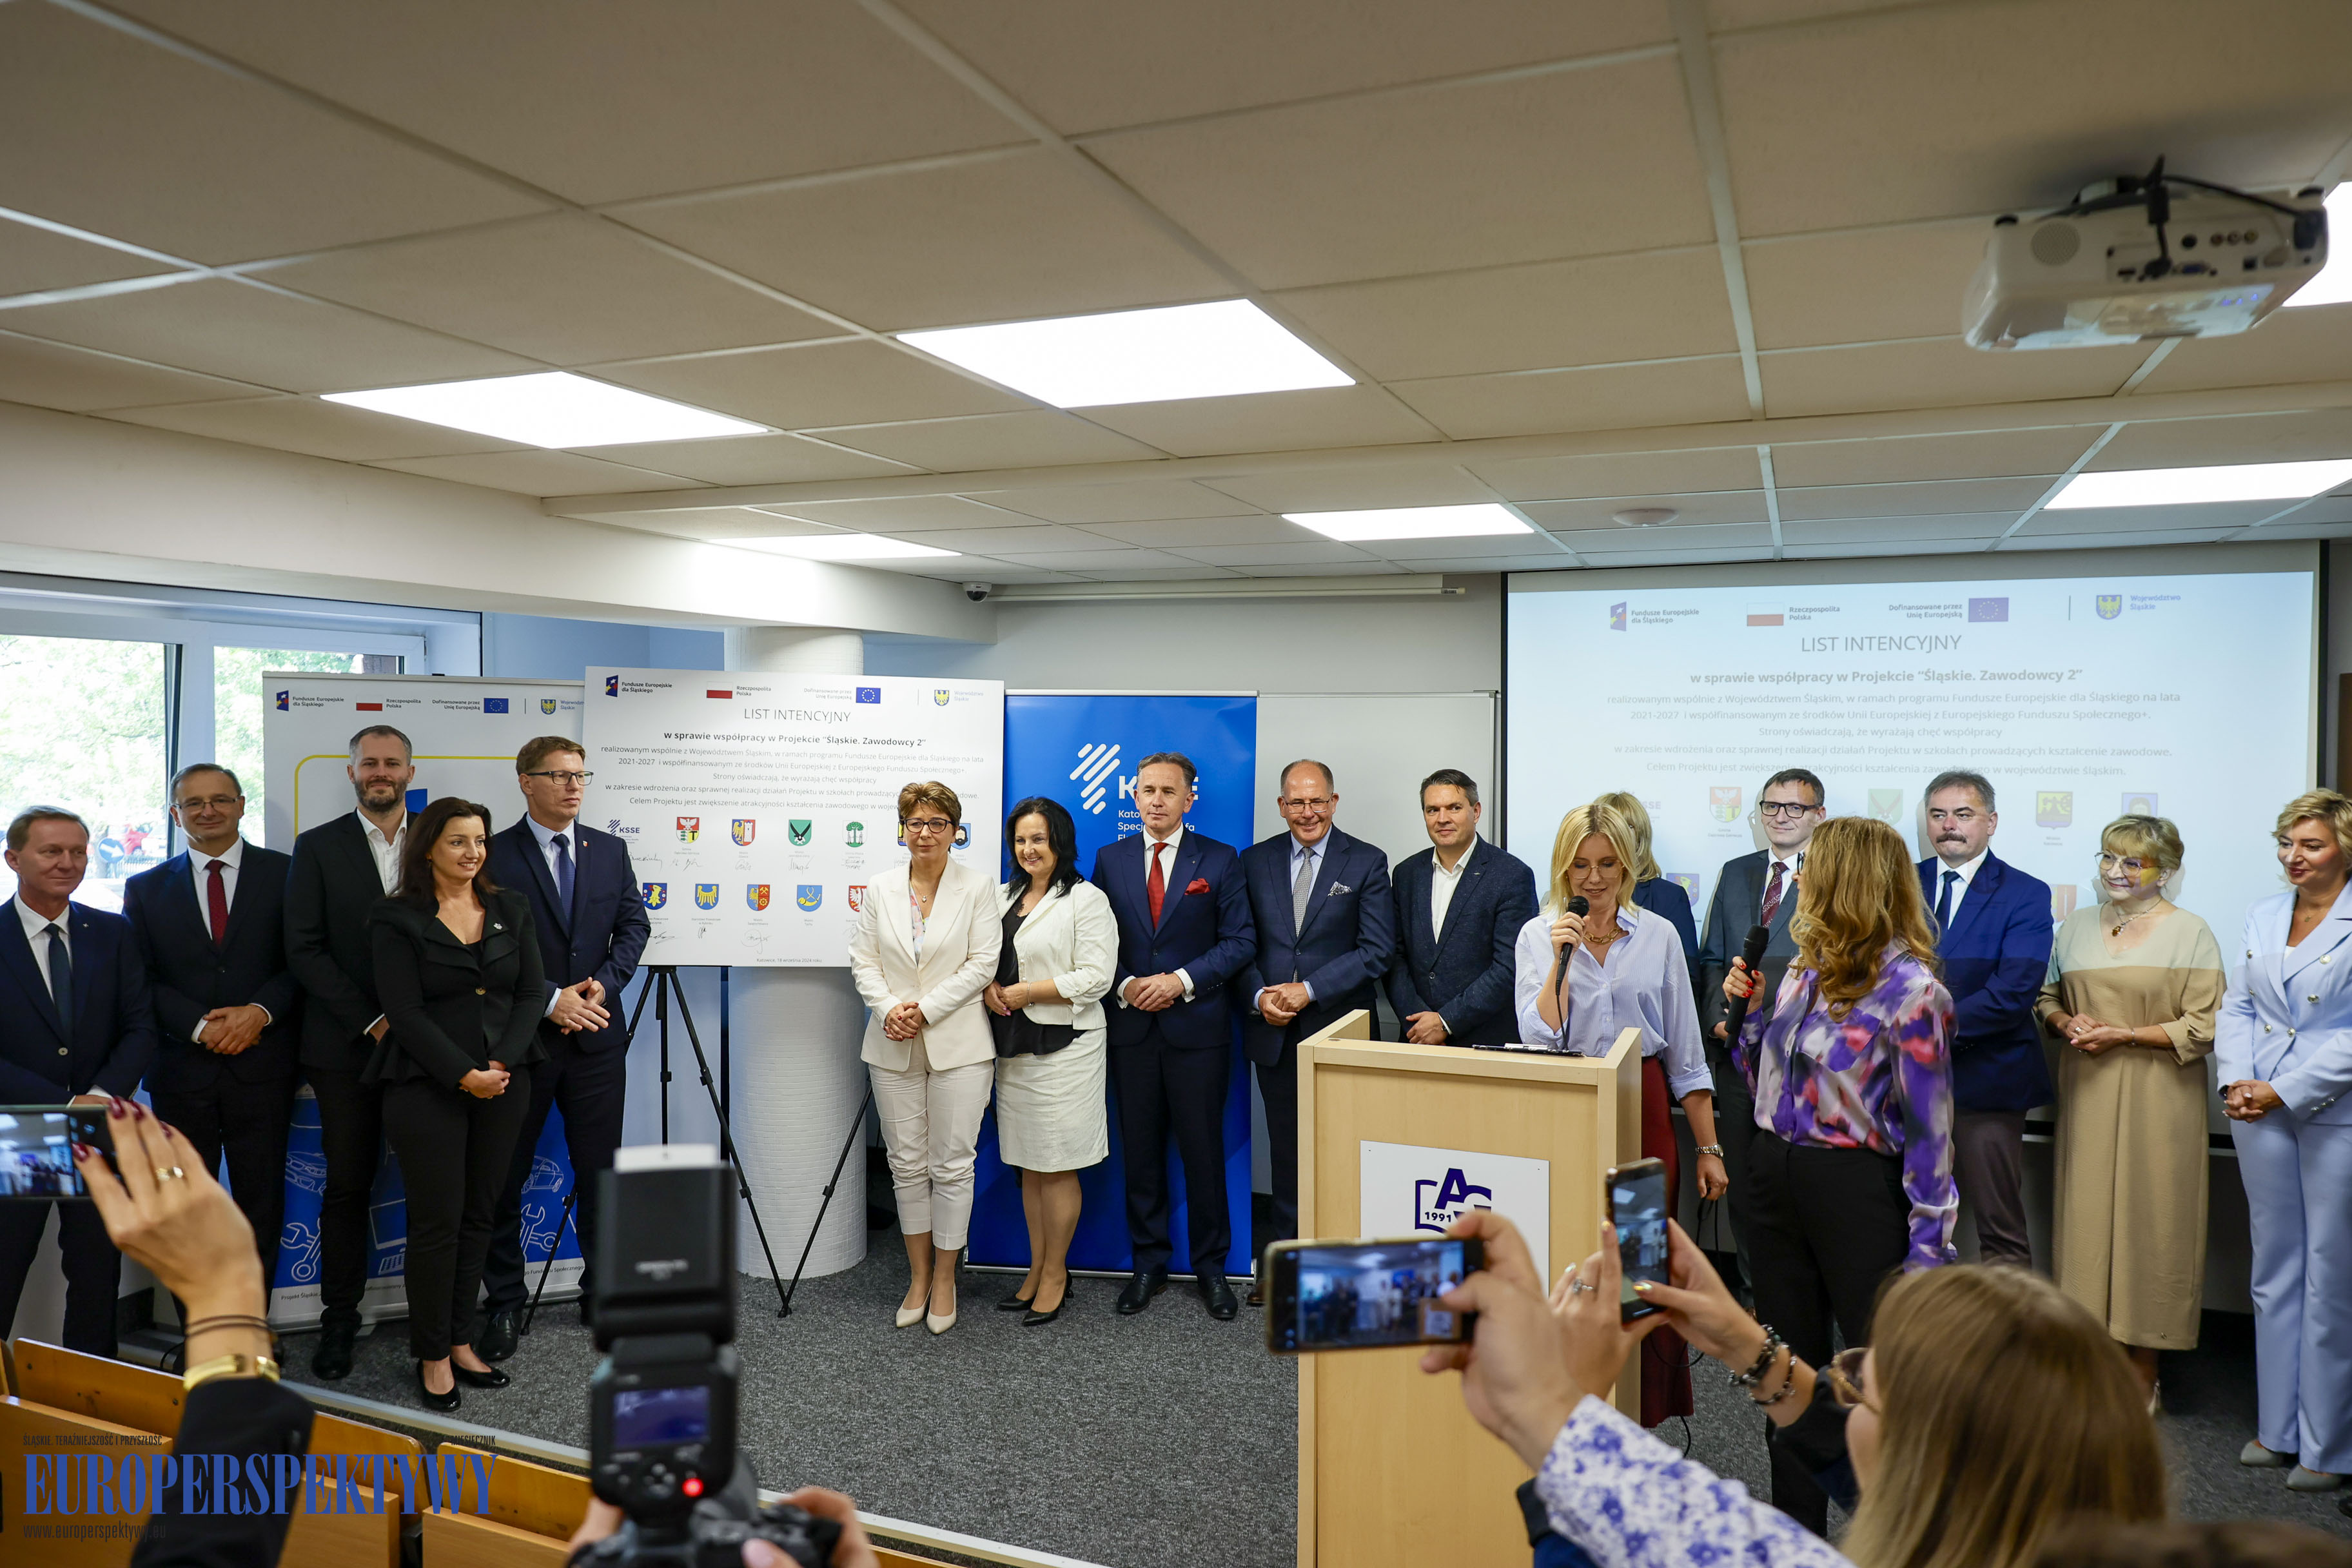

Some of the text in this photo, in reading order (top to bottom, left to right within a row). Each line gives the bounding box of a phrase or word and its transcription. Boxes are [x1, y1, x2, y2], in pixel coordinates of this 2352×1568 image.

[1630, 608, 1700, 618] Fundusze Europejskie
[1788, 605, 1840, 614] Rzeczpospolita
[1801, 634, 1962, 653] LIST INTENCYJNY
[1703, 671, 1755, 685] sprawie
[1757, 671, 1834, 685] współpracy
[1851, 670, 1915, 684] Projekcie
[1979, 669, 2064, 683] Zawodowcy
[743, 708, 850, 723] LIST INTENCYJNY
[673, 732, 711, 741] sprawie
[712, 732, 766, 743] współpracy
[778, 734, 820, 744] Projekcie
[862, 737, 914, 748] Zawodowcy
[1424, 1211, 1451, 1222] 1991
